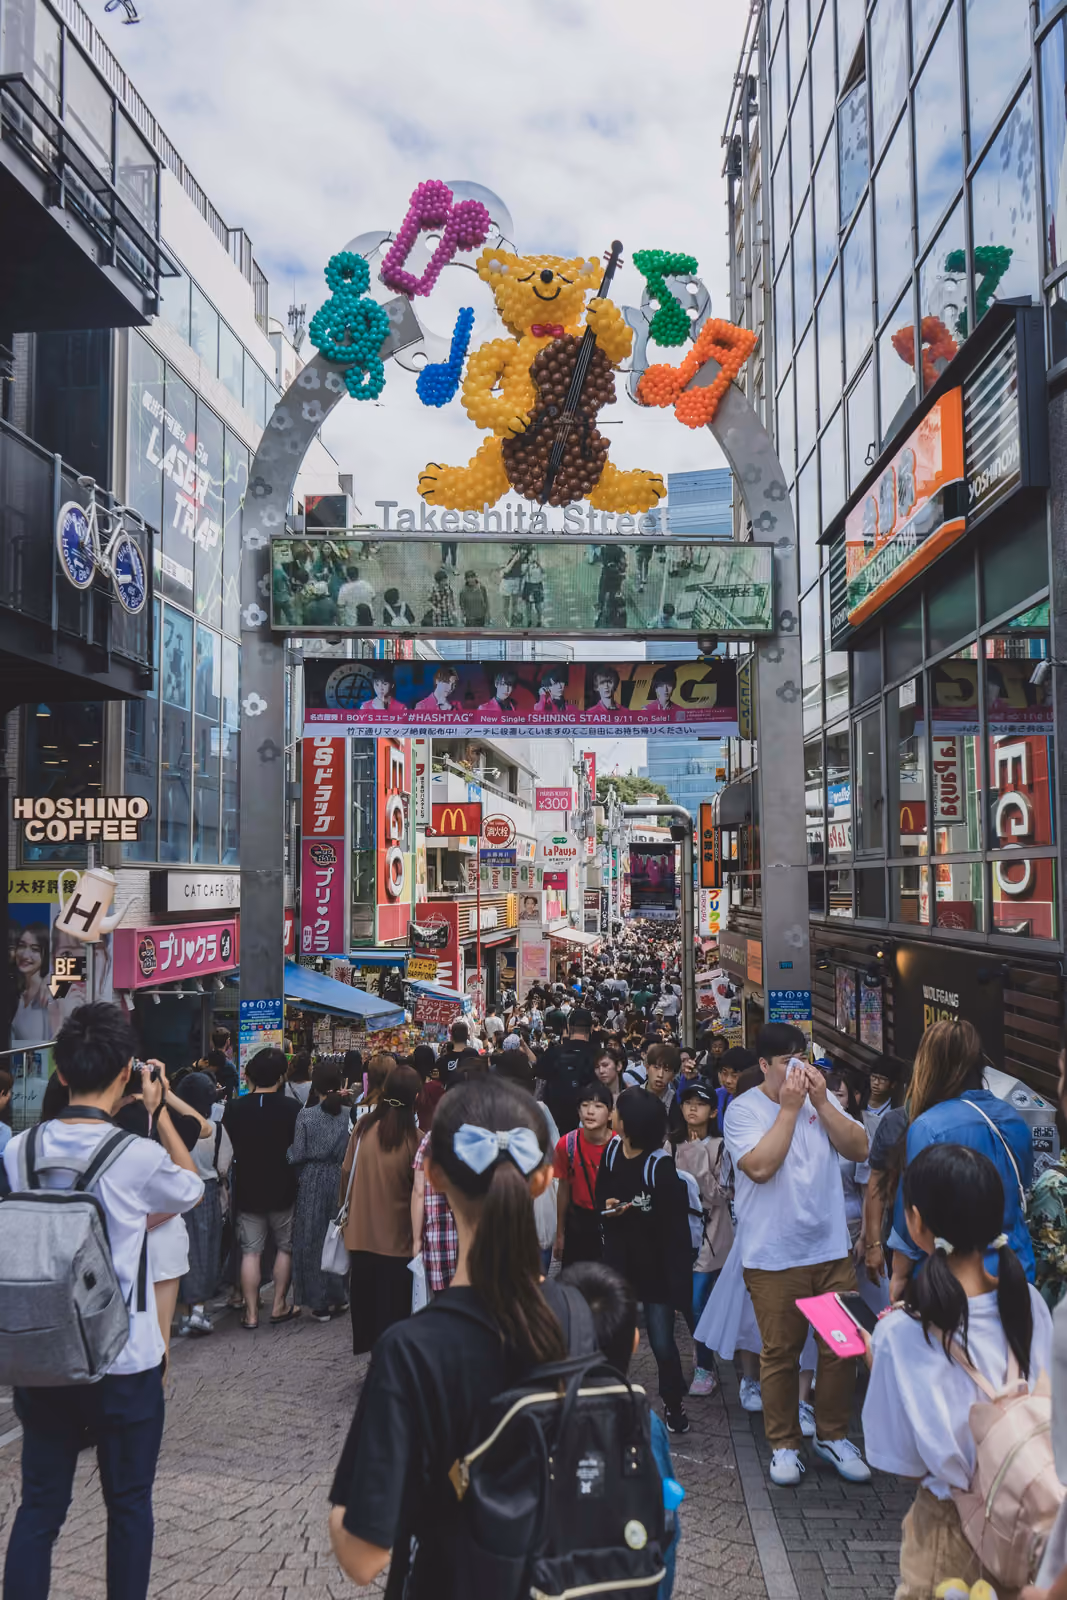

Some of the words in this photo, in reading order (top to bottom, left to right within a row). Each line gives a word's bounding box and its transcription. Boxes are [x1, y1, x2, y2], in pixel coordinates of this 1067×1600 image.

[146, 425, 210, 507] LASER
[968, 440, 1020, 504] YOSHINOYA
[173, 492, 220, 552] TRAP
[375, 500, 549, 533] Takeshita
[563, 503, 673, 536] Street
[864, 522, 917, 590] YOSHINOYA
[831, 607, 850, 630] YOSHIN
[501, 716, 526, 724] Single
[614, 715, 633, 723] 9/11
[651, 714, 671, 722] Sale!
[13, 797, 149, 819] HOSHINO
[539, 798, 569, 810] ¥300
[386, 738, 405, 897] EGO
[25, 820, 138, 842] COFFEE
[486, 826, 509, 837] 消火栓
[553, 846, 577, 858] Pausa
[184, 884, 201, 897] CAT
[203, 883, 224, 897] CAFE
[64, 893, 102, 932] H
[708, 889, 722, 934] プリクラ
[922, 985, 960, 1008] WOLFGANG
